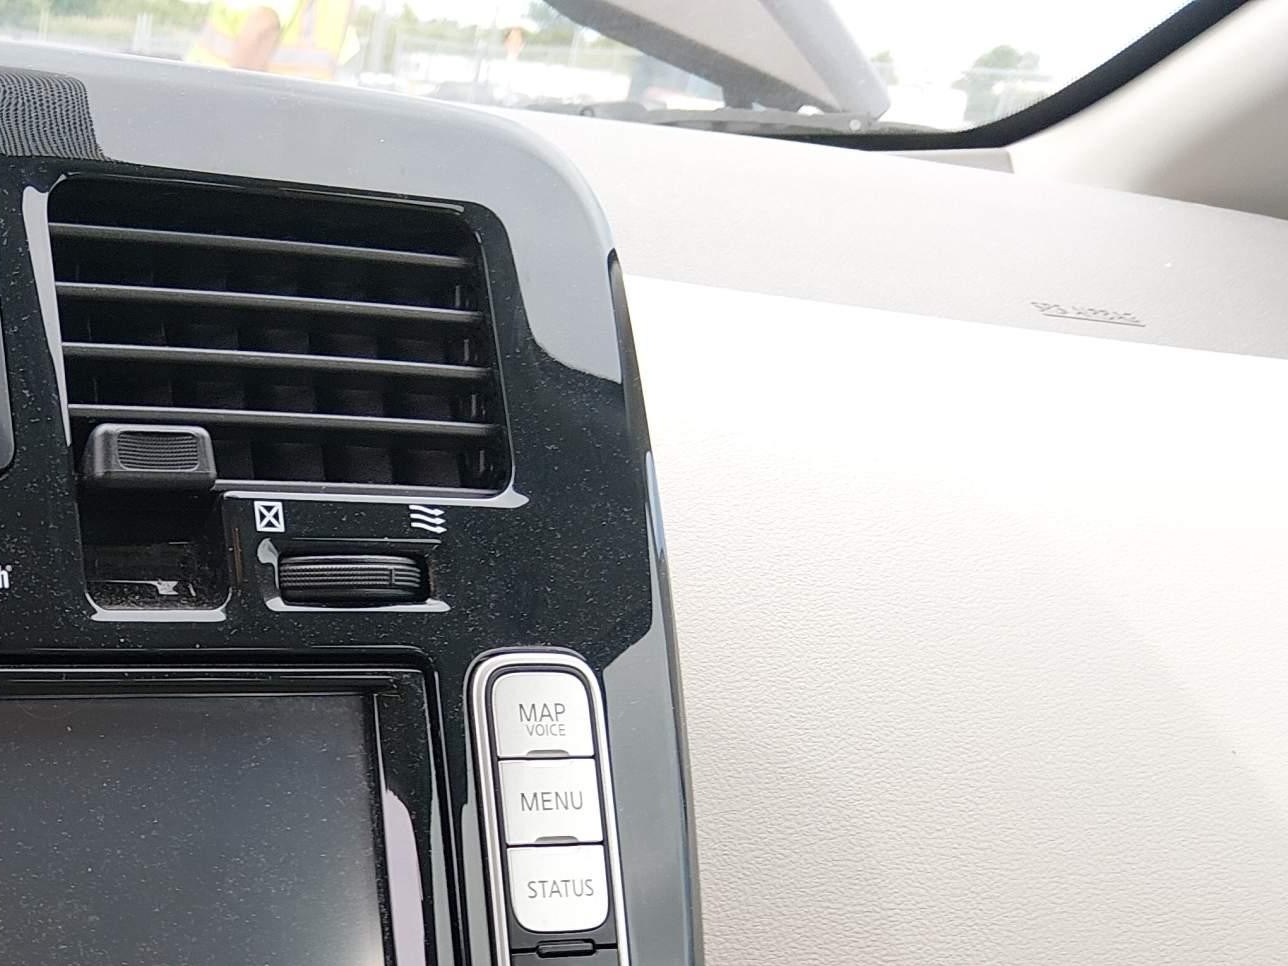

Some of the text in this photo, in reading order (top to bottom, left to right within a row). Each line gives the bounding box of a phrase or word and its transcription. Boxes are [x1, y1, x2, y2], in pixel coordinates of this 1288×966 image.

[518, 703, 566, 722] MAP
[525, 723, 567, 737] VOICE
[520, 791, 584, 812] MENU
[527, 879, 594, 899] STATUS
